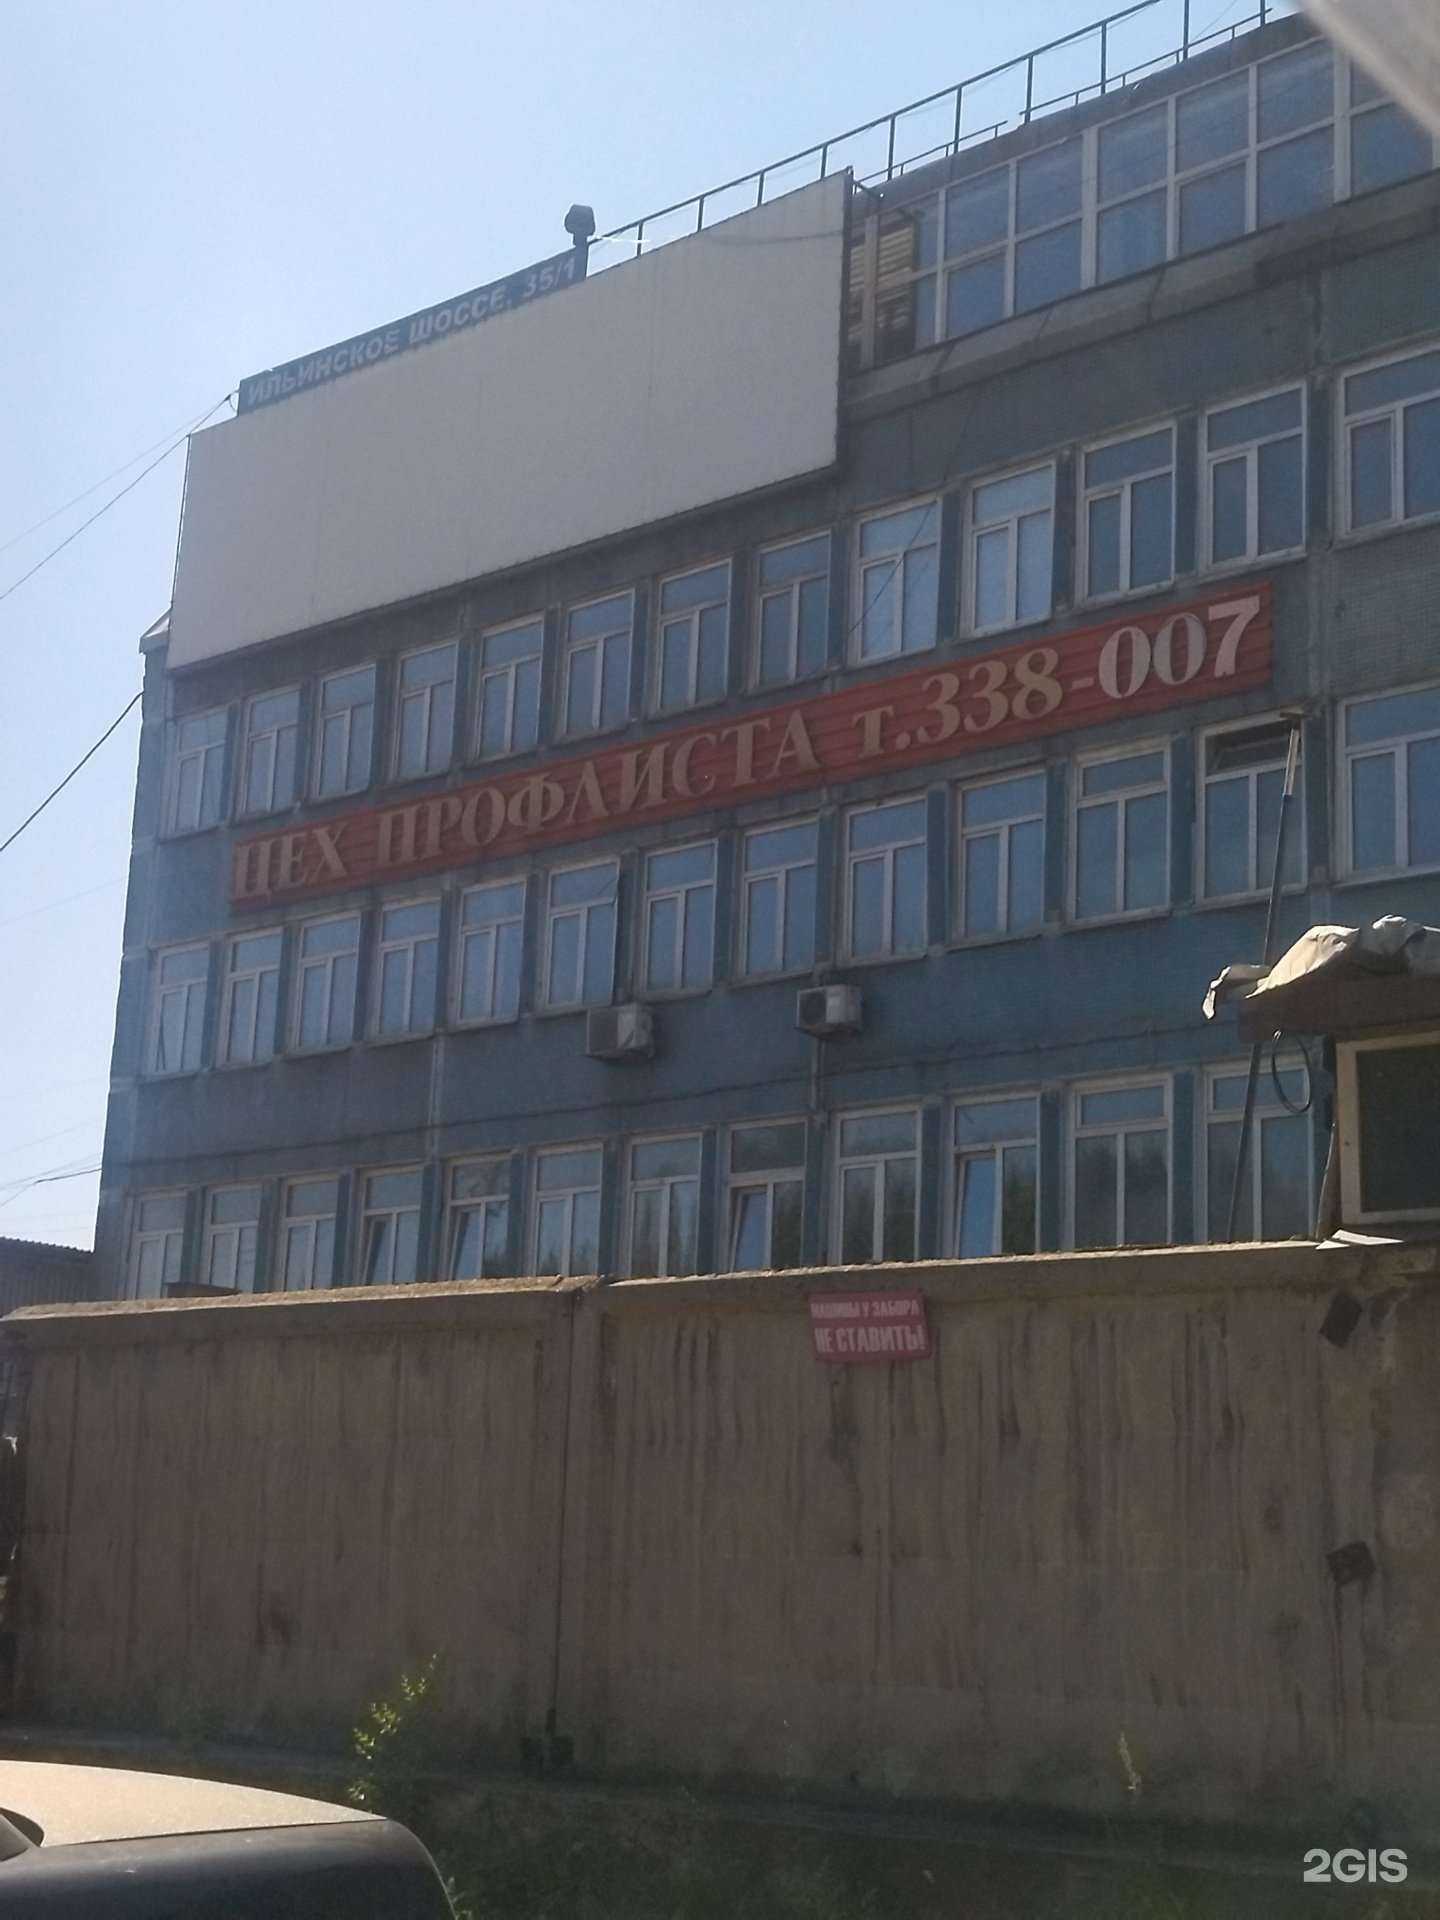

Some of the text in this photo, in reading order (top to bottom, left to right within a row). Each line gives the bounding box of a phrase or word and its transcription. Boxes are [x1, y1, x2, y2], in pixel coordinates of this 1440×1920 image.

[249, 330, 401, 404] ИЛЬИНСКОЕ
[523, 256, 577, 299] 35/1
[233, 824, 349, 899] ЦЕХ
[376, 710, 824, 865] ПРОФЛИСТА
[814, 1325, 926, 1353] НЕ СТАВИТЬ!
[862, 1301, 870, 1317] У
